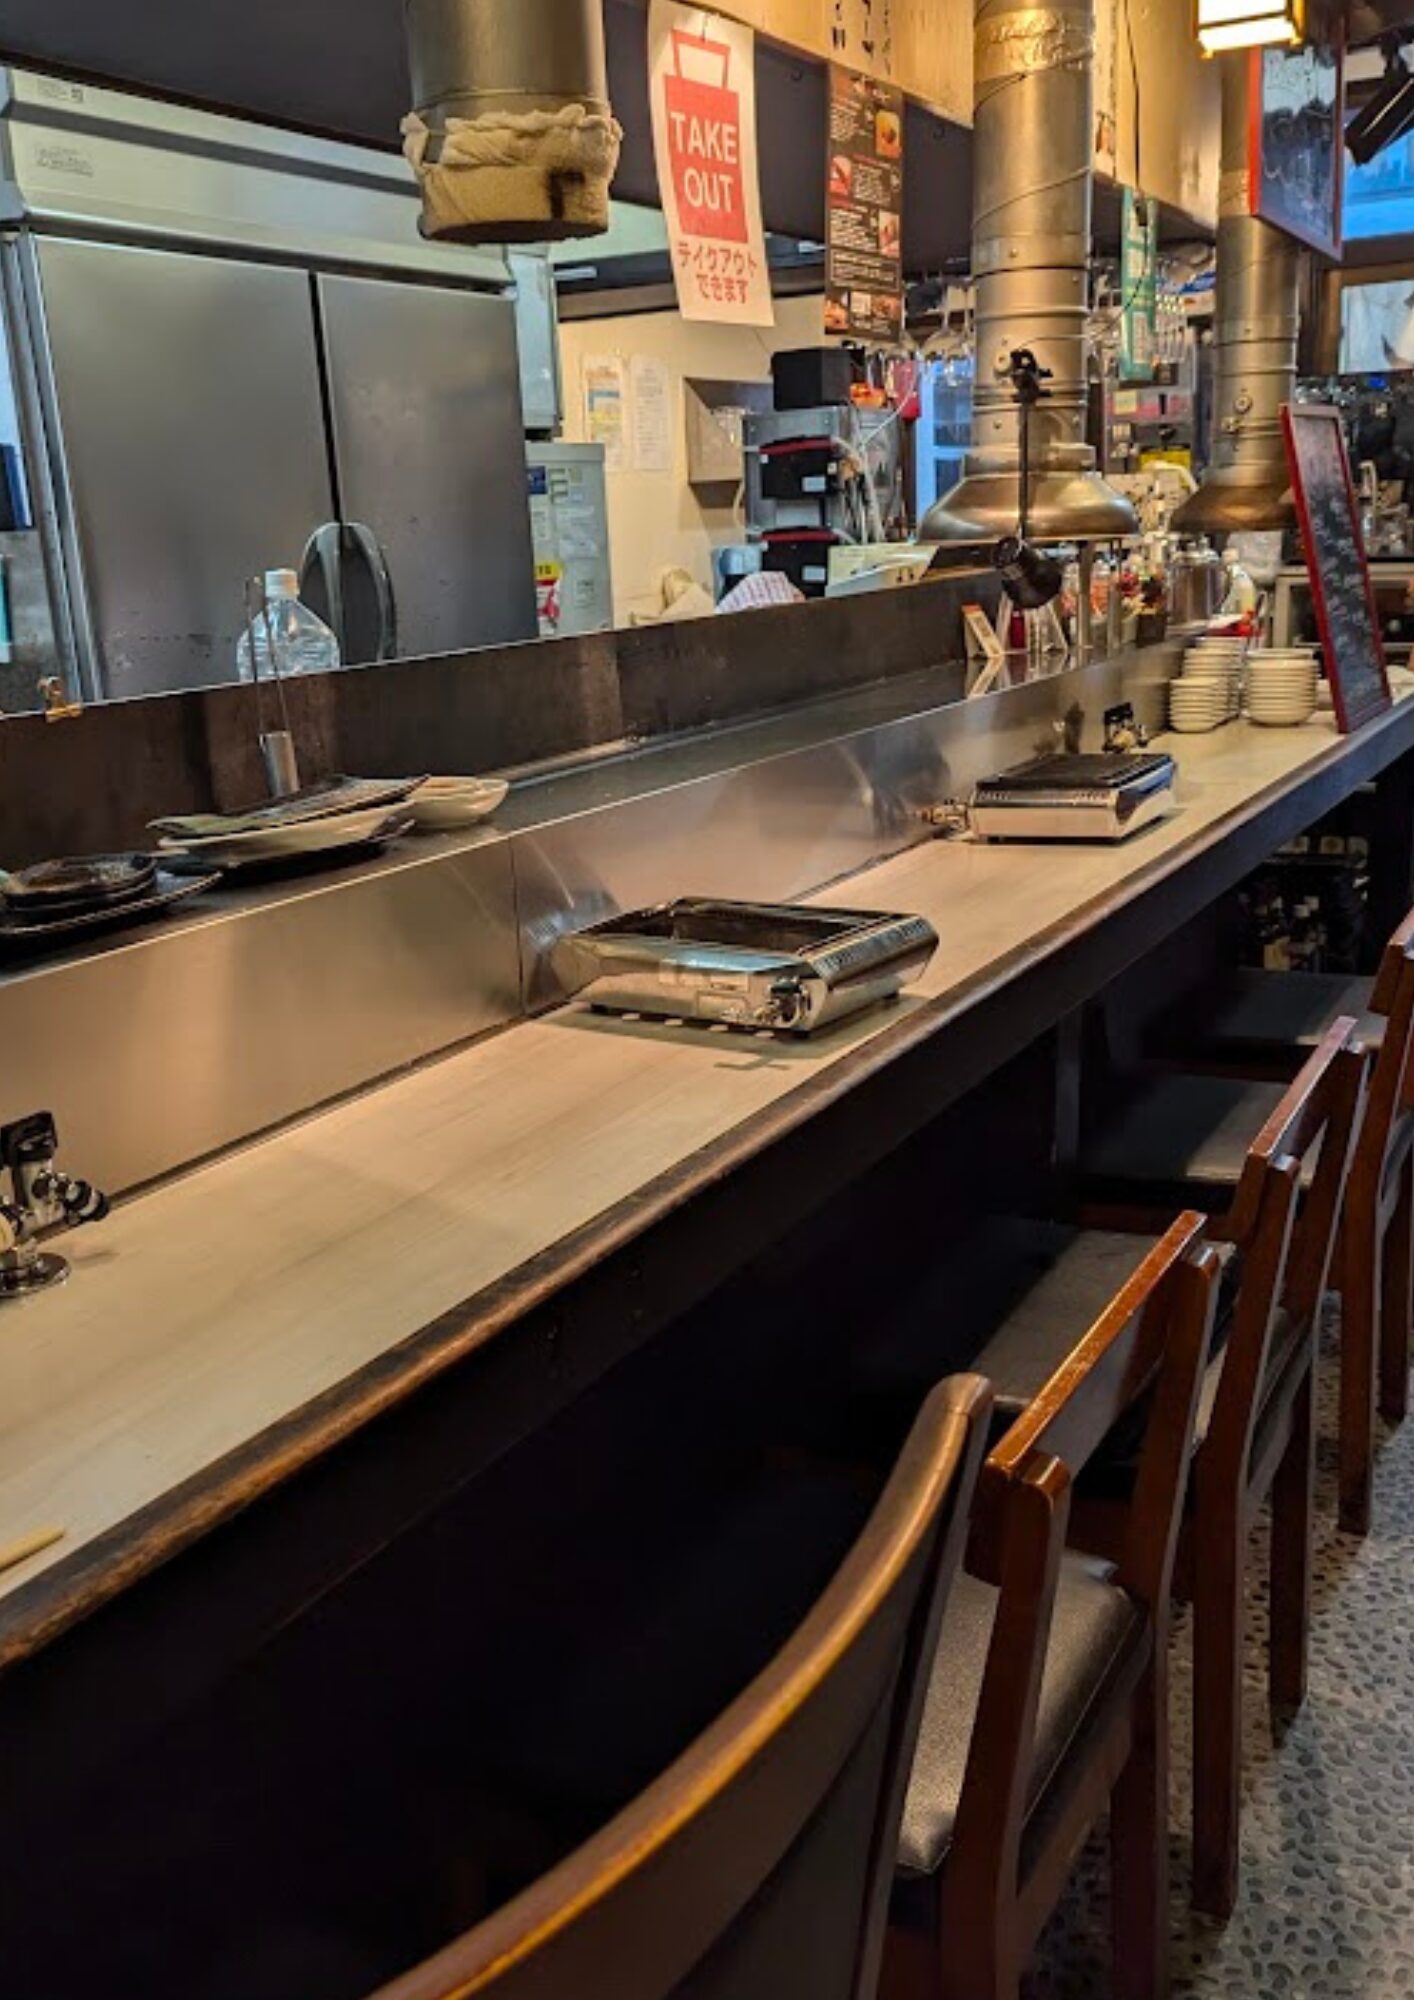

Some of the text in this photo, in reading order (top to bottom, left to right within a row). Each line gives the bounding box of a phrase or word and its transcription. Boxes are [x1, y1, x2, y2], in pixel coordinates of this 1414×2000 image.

[670, 112, 737, 164] TAKE
[684, 168, 733, 213] OUT
[678, 242, 757, 277] テイクアウト
[696, 273, 748, 304] できます
